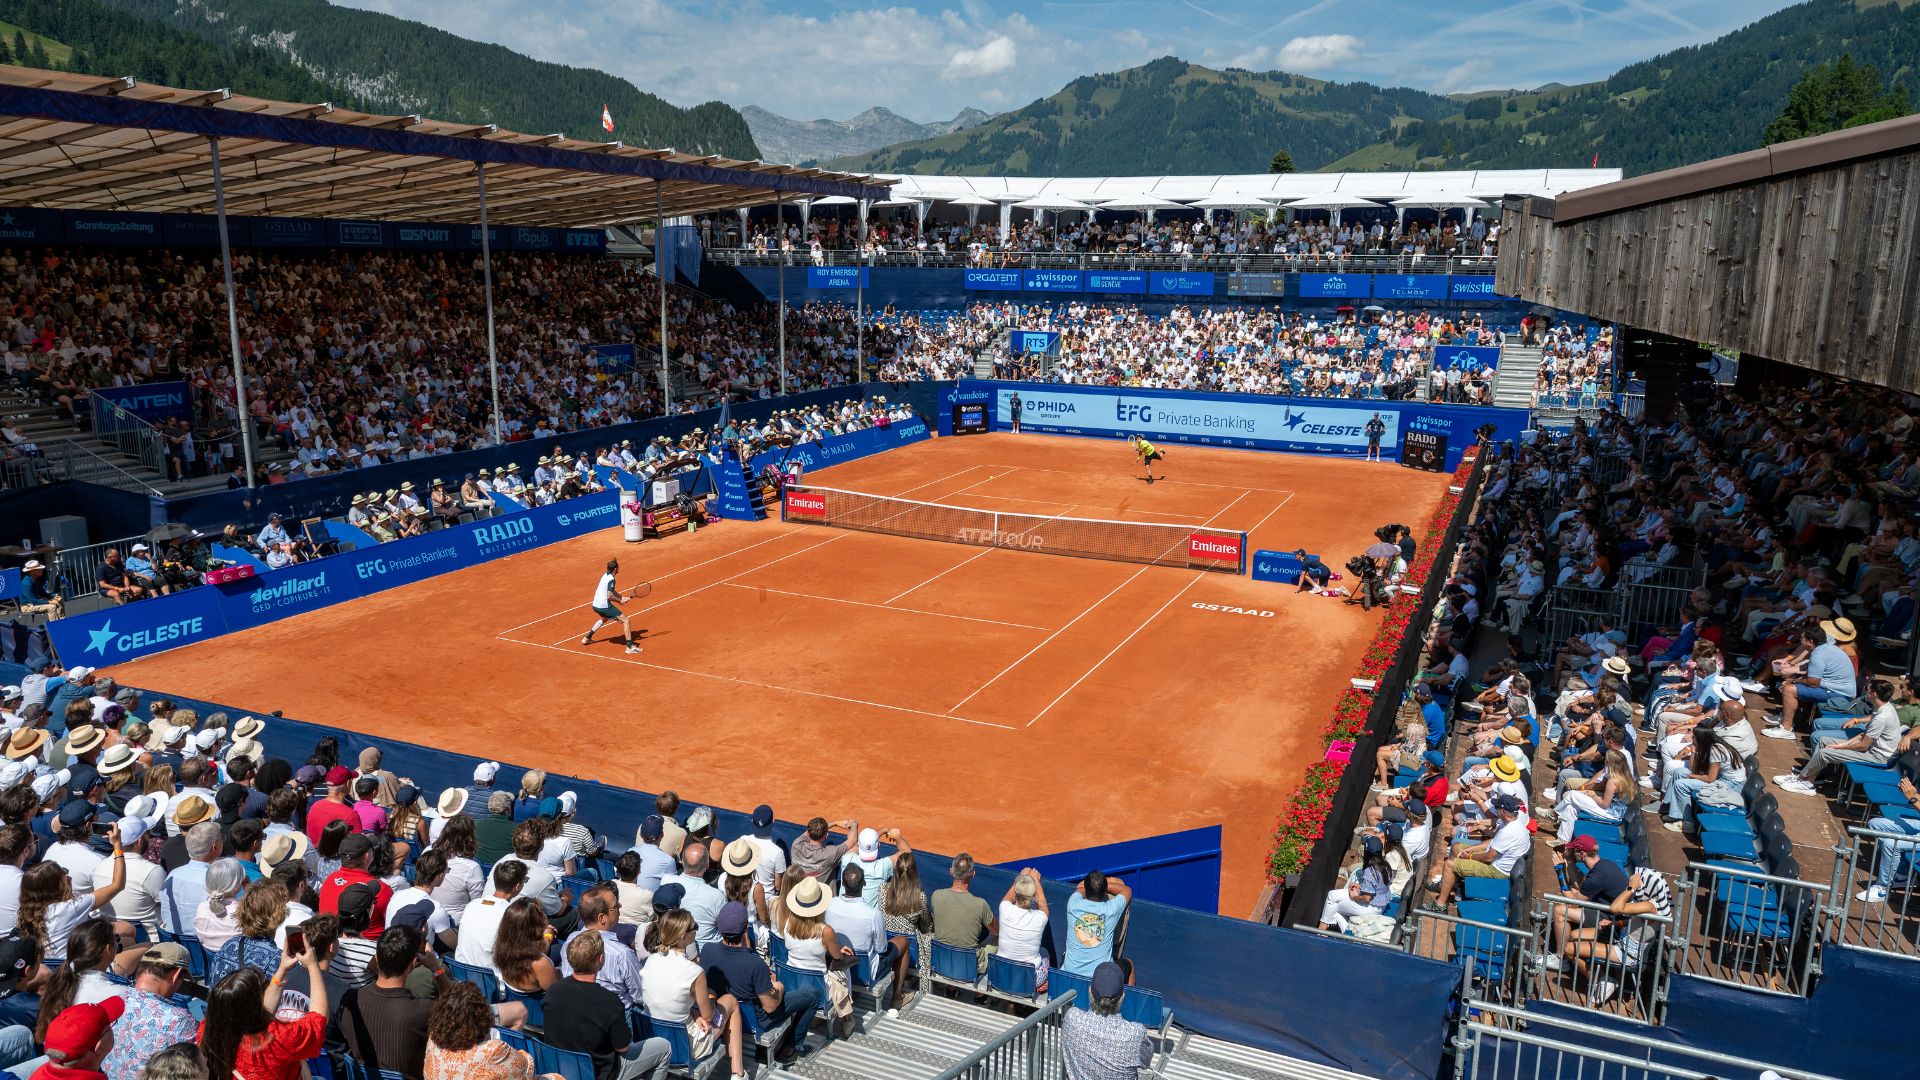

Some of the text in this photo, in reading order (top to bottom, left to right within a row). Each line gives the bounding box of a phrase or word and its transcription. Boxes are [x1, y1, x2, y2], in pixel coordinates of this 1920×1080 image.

[75, 220, 154, 234] SonntagsZeitung
[831, 269, 858, 277] EMERSO
[968, 273, 1018, 282] ORGATENT
[1036, 272, 1077, 283] swisspor
[1324, 281, 1347, 289] evian
[1026, 338, 1045, 347] RTS
[959, 391, 989, 400] vaudoise
[1037, 401, 1076, 413] PHIDA
[1116, 404, 1256, 432] EFG Private Banking
[1416, 415, 1453, 427] swisspor
[1301, 424, 1362, 436] CELESTE
[1407, 432, 1437, 444] RADO
[830, 443, 856, 455] MAZDA
[789, 497, 824, 510] Emirates
[573, 504, 617, 521] FOURTEEN
[472, 517, 533, 546] RADO
[479, 535, 538, 555] SWITZERLAND
[997, 530, 1044, 550] TOUR
[1192, 540, 1237, 554] Emirates
[356, 546, 458, 579] EFG Private Banking
[250, 572, 324, 604] devillard
[252, 602, 271, 613] GED
[277, 590, 318, 607] COPIEURS
[1191, 602, 1275, 617] GSTAAD
[117, 616, 202, 652] CELESTE
